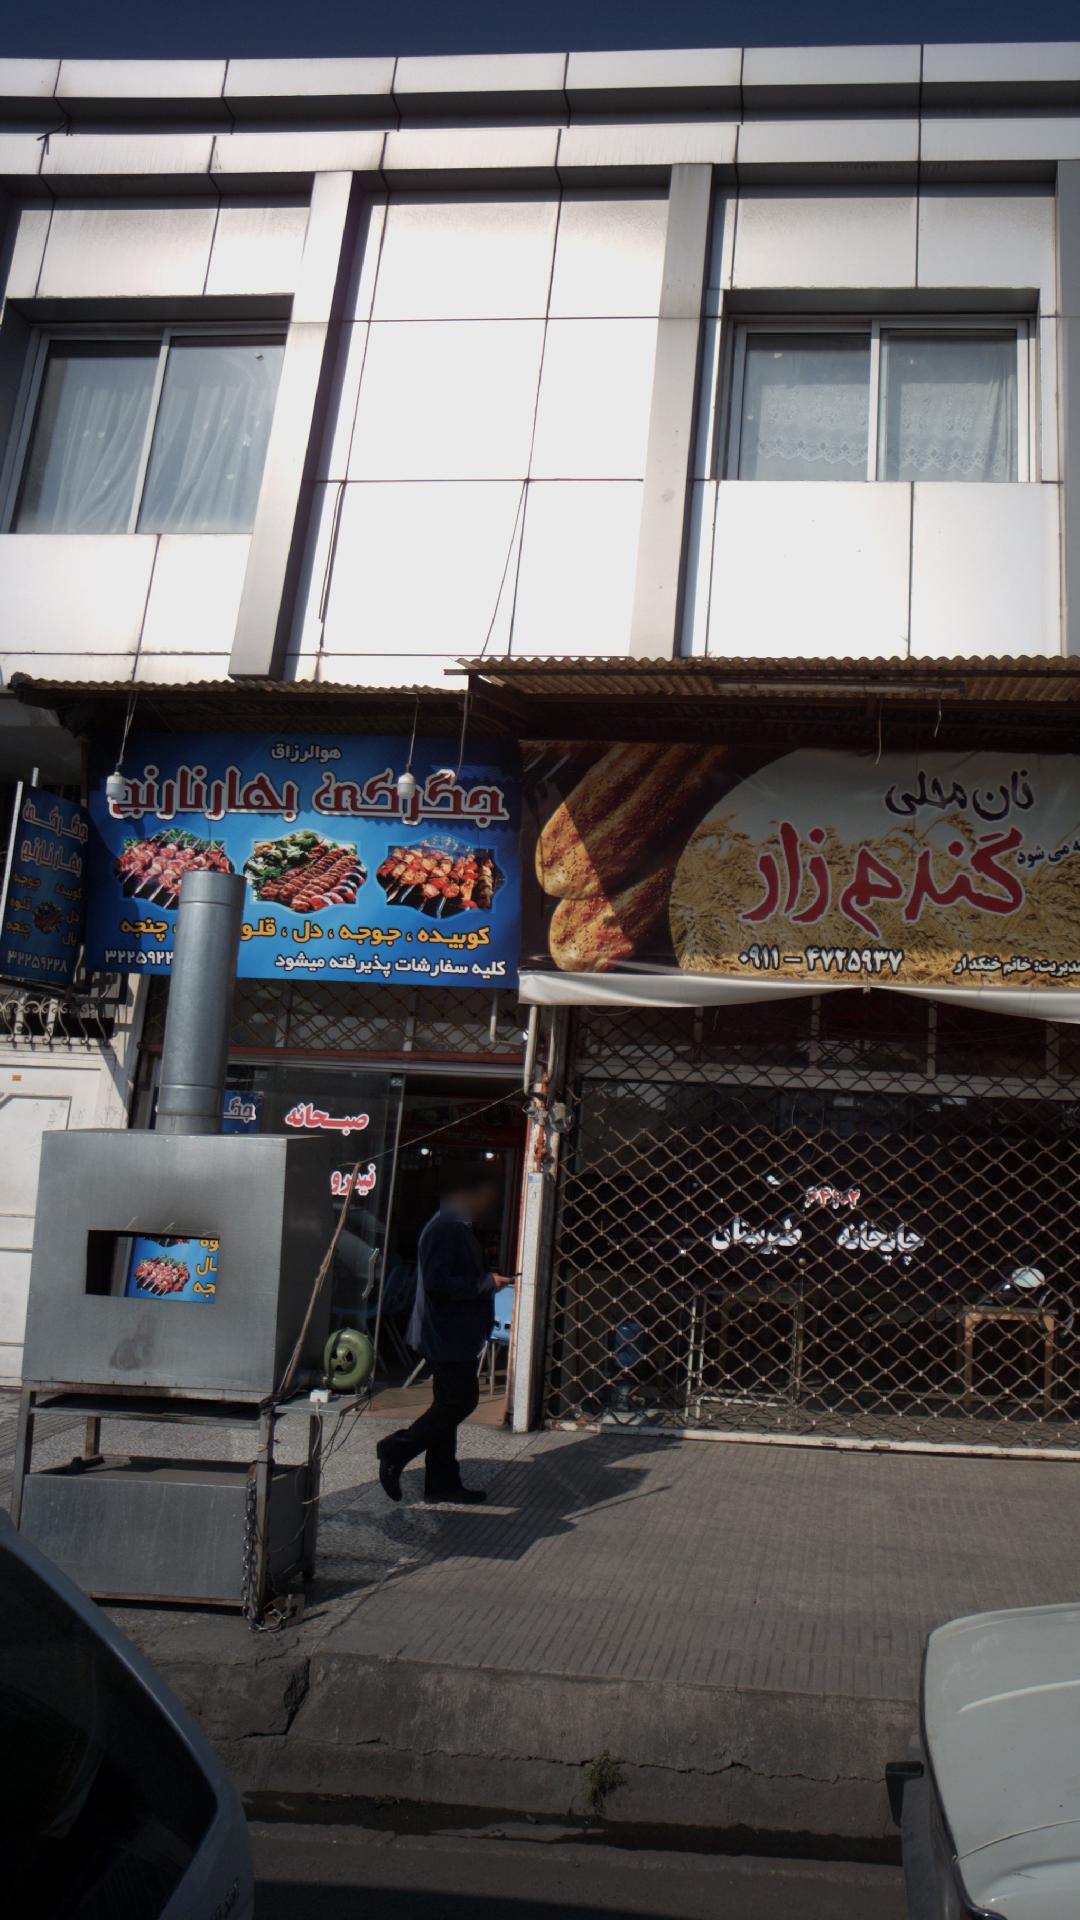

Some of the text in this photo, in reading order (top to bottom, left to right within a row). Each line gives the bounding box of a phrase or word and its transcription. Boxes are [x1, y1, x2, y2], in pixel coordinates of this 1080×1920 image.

[271, 743, 342, 763] هوالرزاق
[884, 769, 1036, 821] نان محلی
[738, 821, 1024, 940] گندم زار
[120, 917, 168, 942] چنجه
[240, 918, 277, 941] قلو
[293, 920, 324, 942] دل
[339, 924, 402, 944] جوجه
[418, 927, 490, 949] کوبیده
[104, 950, 174, 966] ۳۲۲۵۹۲۲
[329, 954, 392, 979] پذیرفته
[394, 957, 469, 976] سفارشات
[1002, 955, 1032, 976] خانم
[471, 959, 507, 980] کلیه
[284, 1102, 370, 1137] صبحانه
[329, 1162, 377, 1197] نیرو
